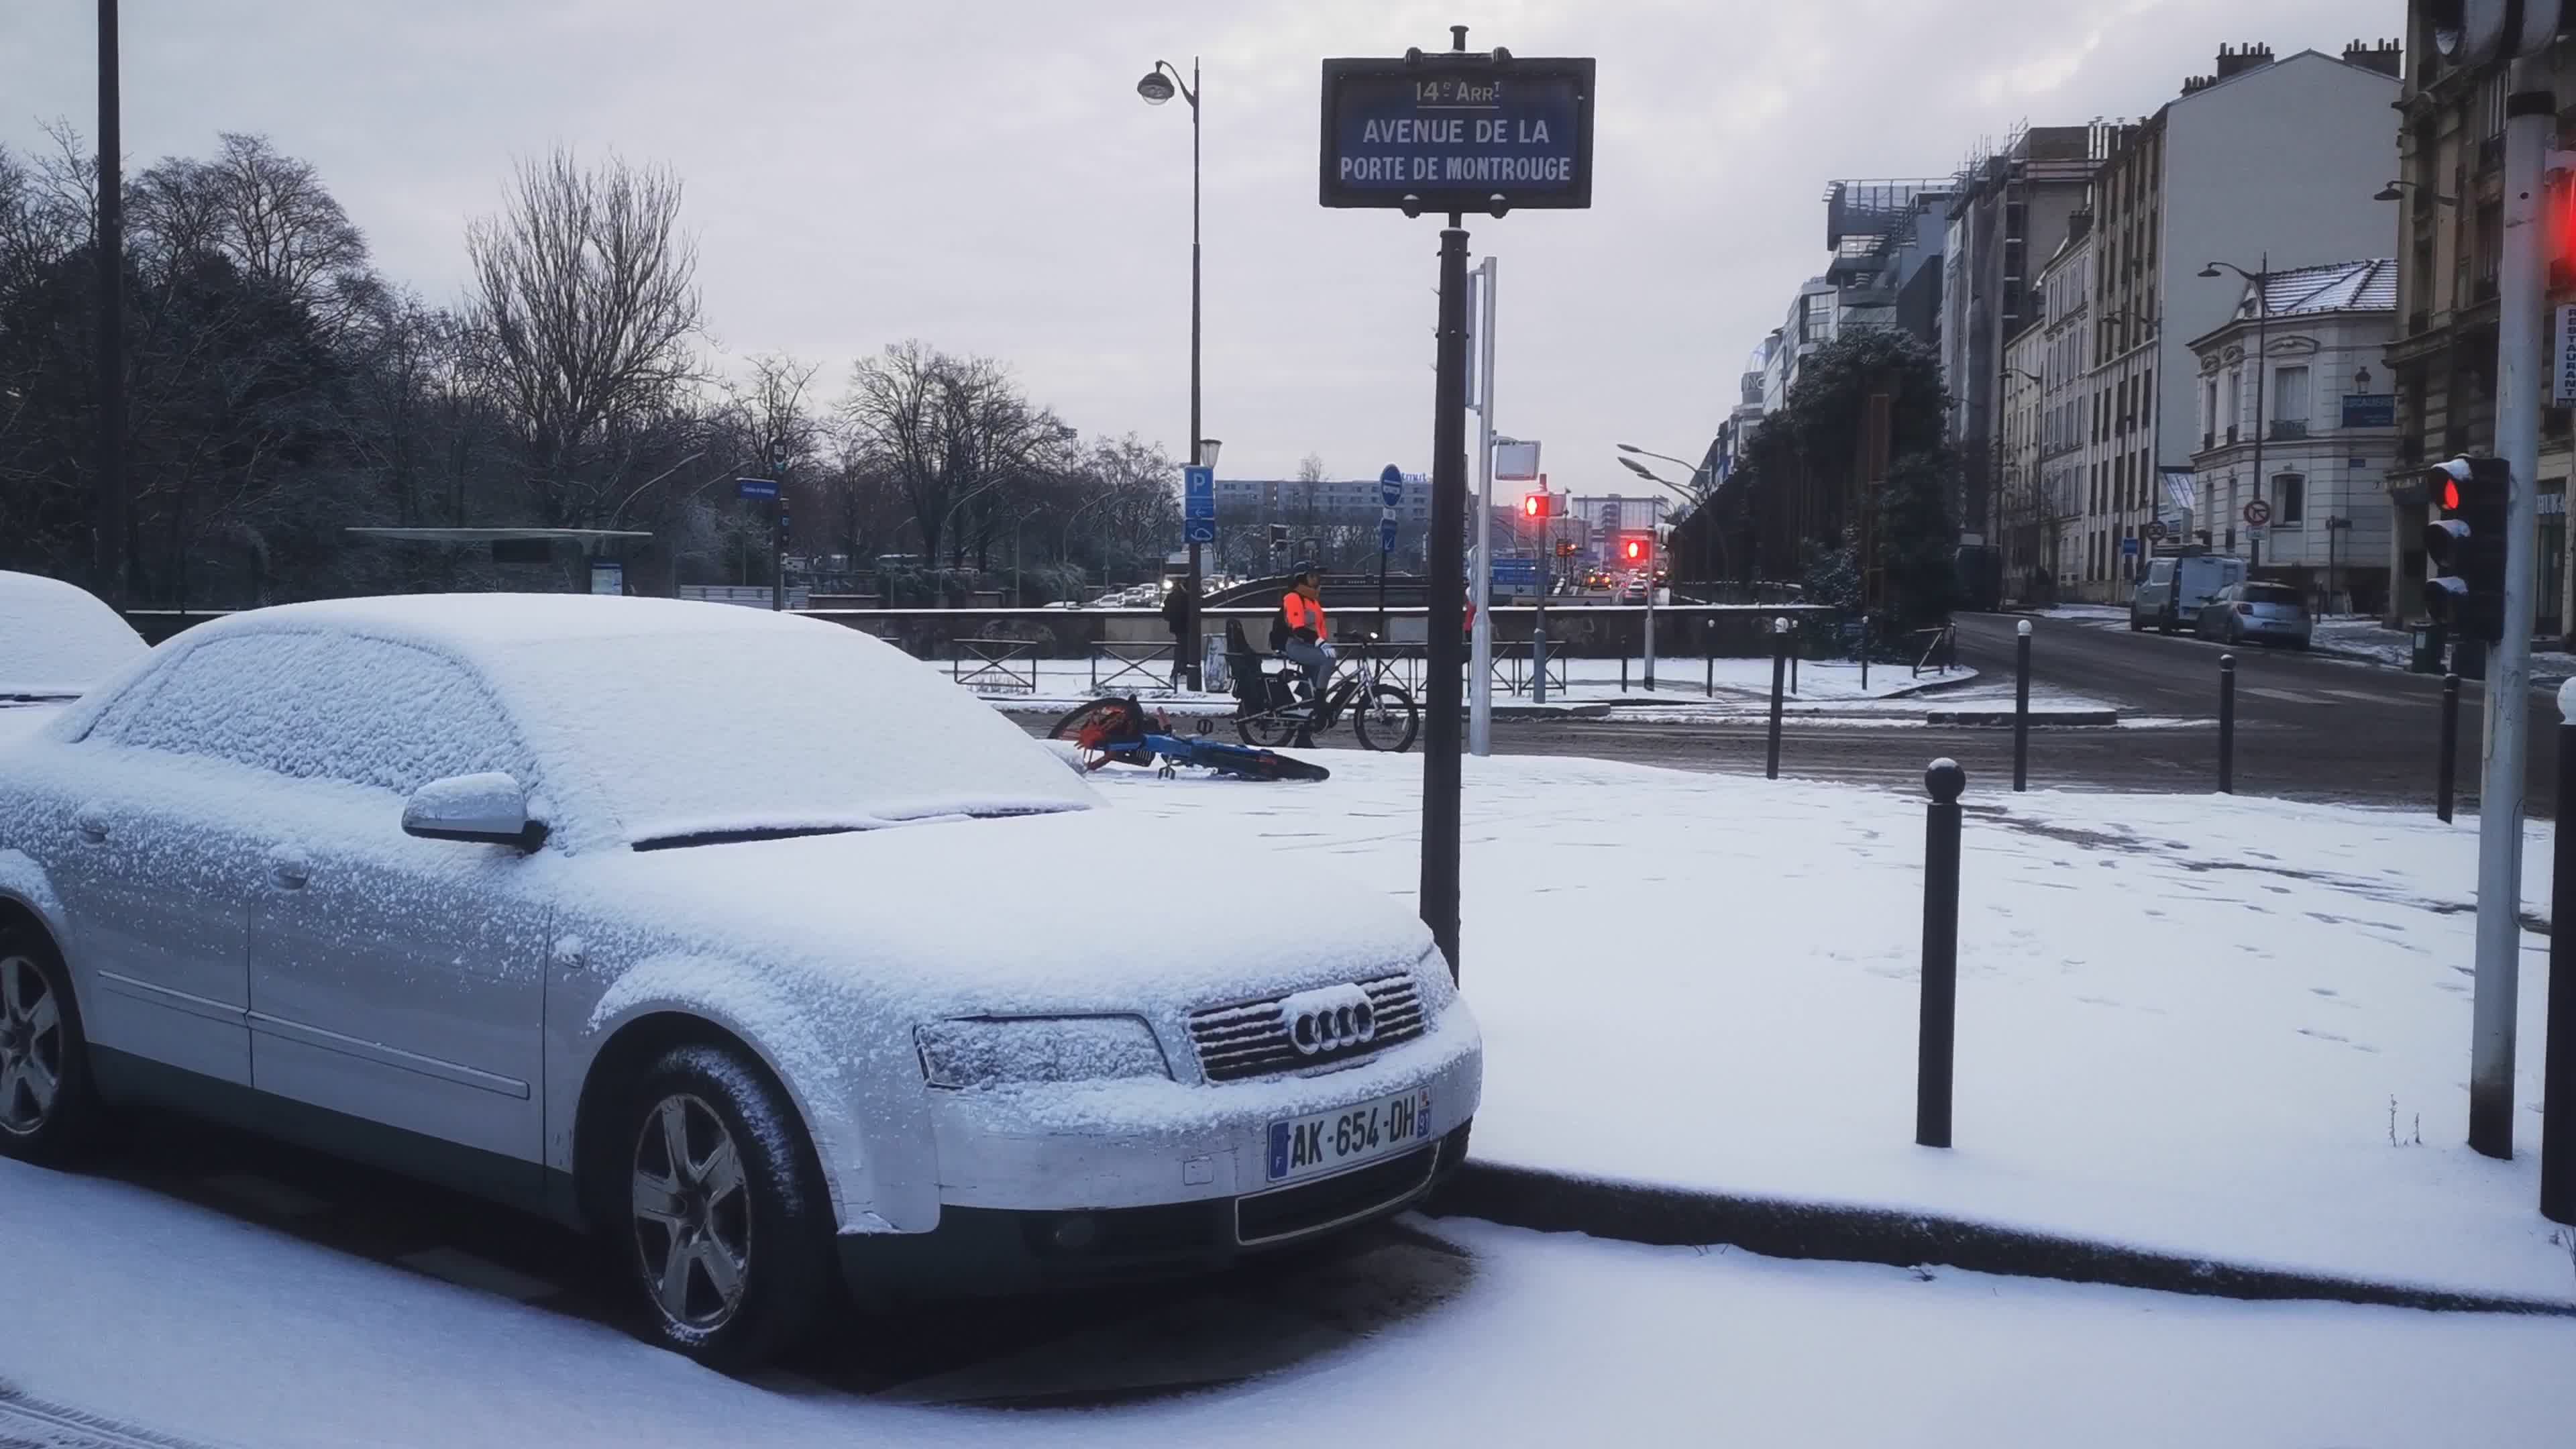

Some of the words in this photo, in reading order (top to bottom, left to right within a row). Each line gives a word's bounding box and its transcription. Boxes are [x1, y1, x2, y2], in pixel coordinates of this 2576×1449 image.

[1362, 119, 1464, 144] AVENUE
[1475, 119, 1508, 144] DE
[1518, 119, 1551, 144] LA
[1340, 156, 1405, 180] PORTE
[1413, 156, 1439, 180] DE
[1446, 156, 1571, 180] MONTROUGE
[1193, 472, 1205, 493] P
[1291, 1094, 1415, 1169] AK-654-DH
